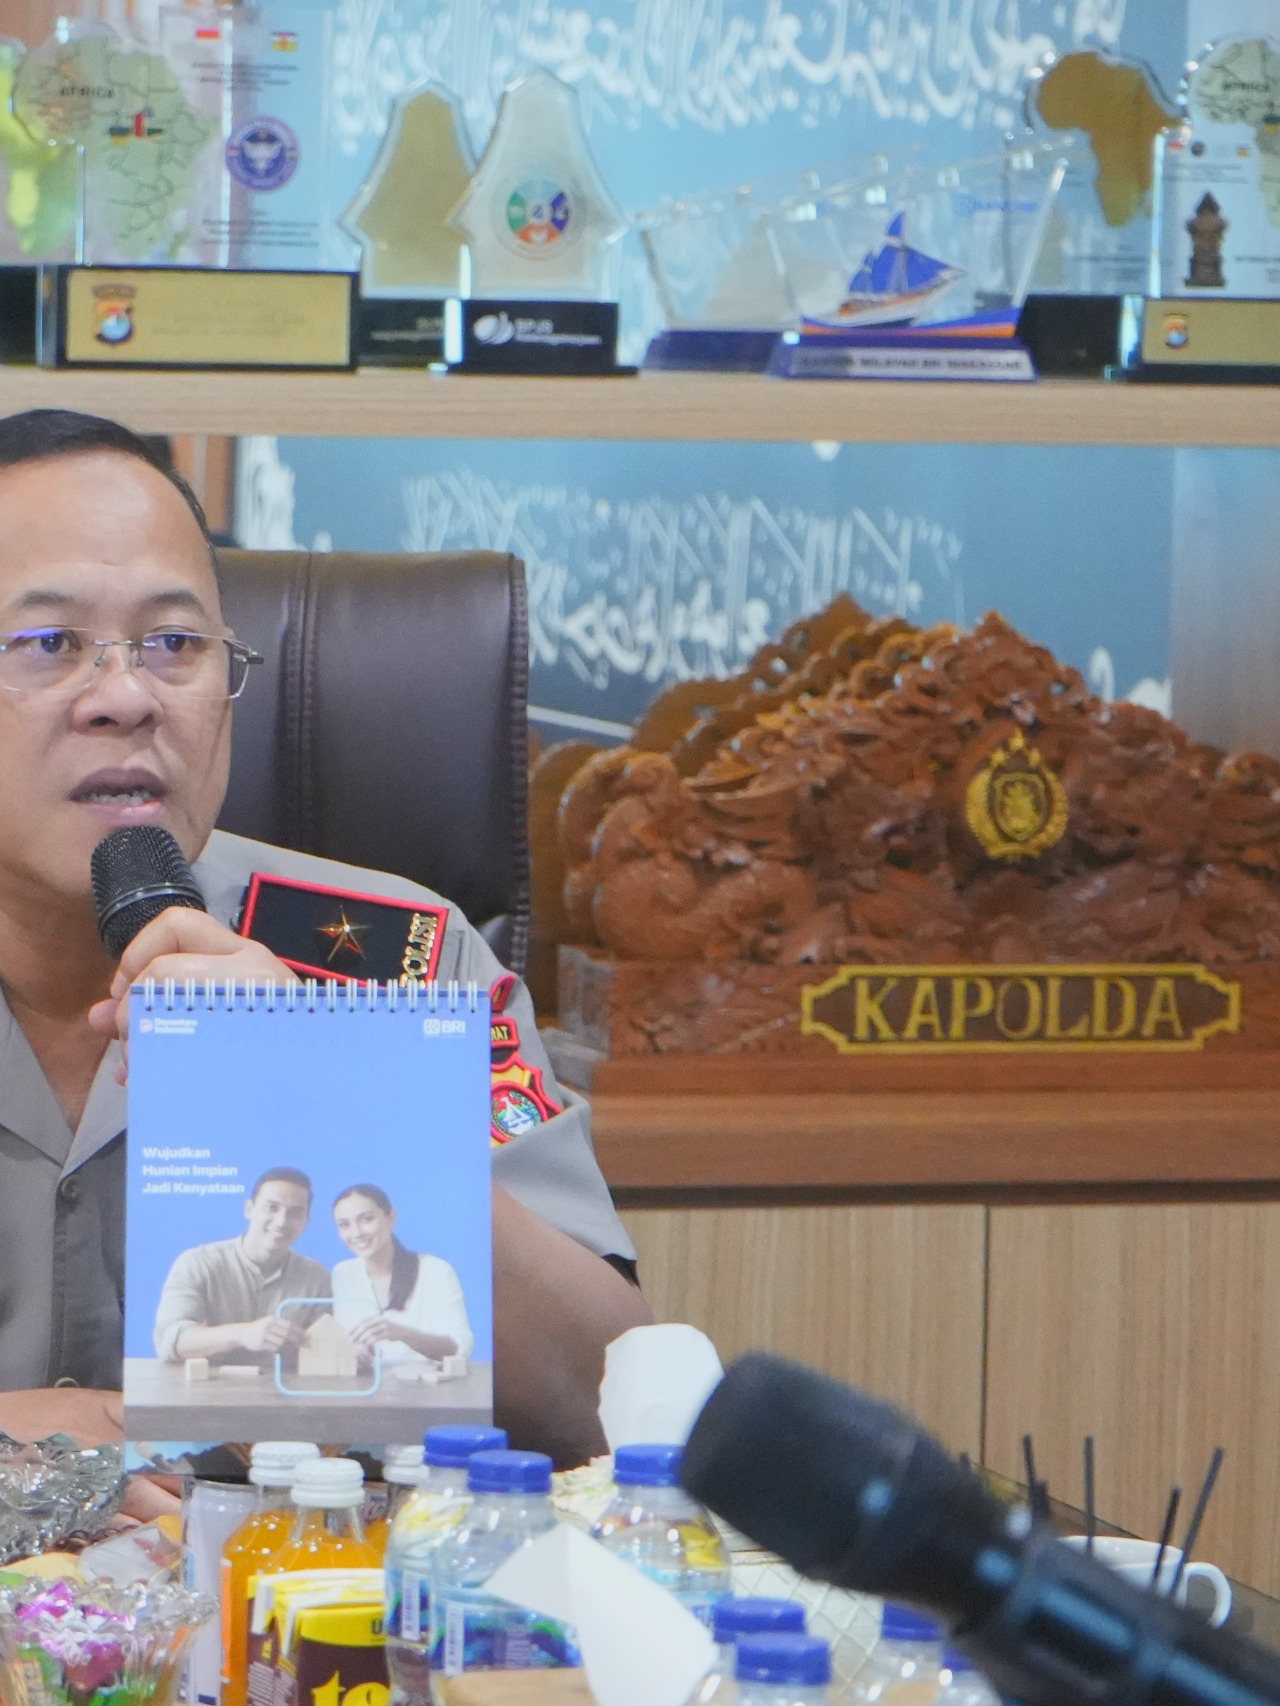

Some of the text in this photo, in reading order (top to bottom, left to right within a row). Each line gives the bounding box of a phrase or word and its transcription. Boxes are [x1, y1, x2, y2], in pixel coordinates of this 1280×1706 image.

[853, 976, 1186, 1040] KAPOLDA
[441, 1019, 467, 1034] BRI
[143, 1146, 211, 1161] Wujudkan
[143, 1164, 238, 1178] Hunian Impian
[142, 1182, 245, 1196] Jadi Kenyataan
